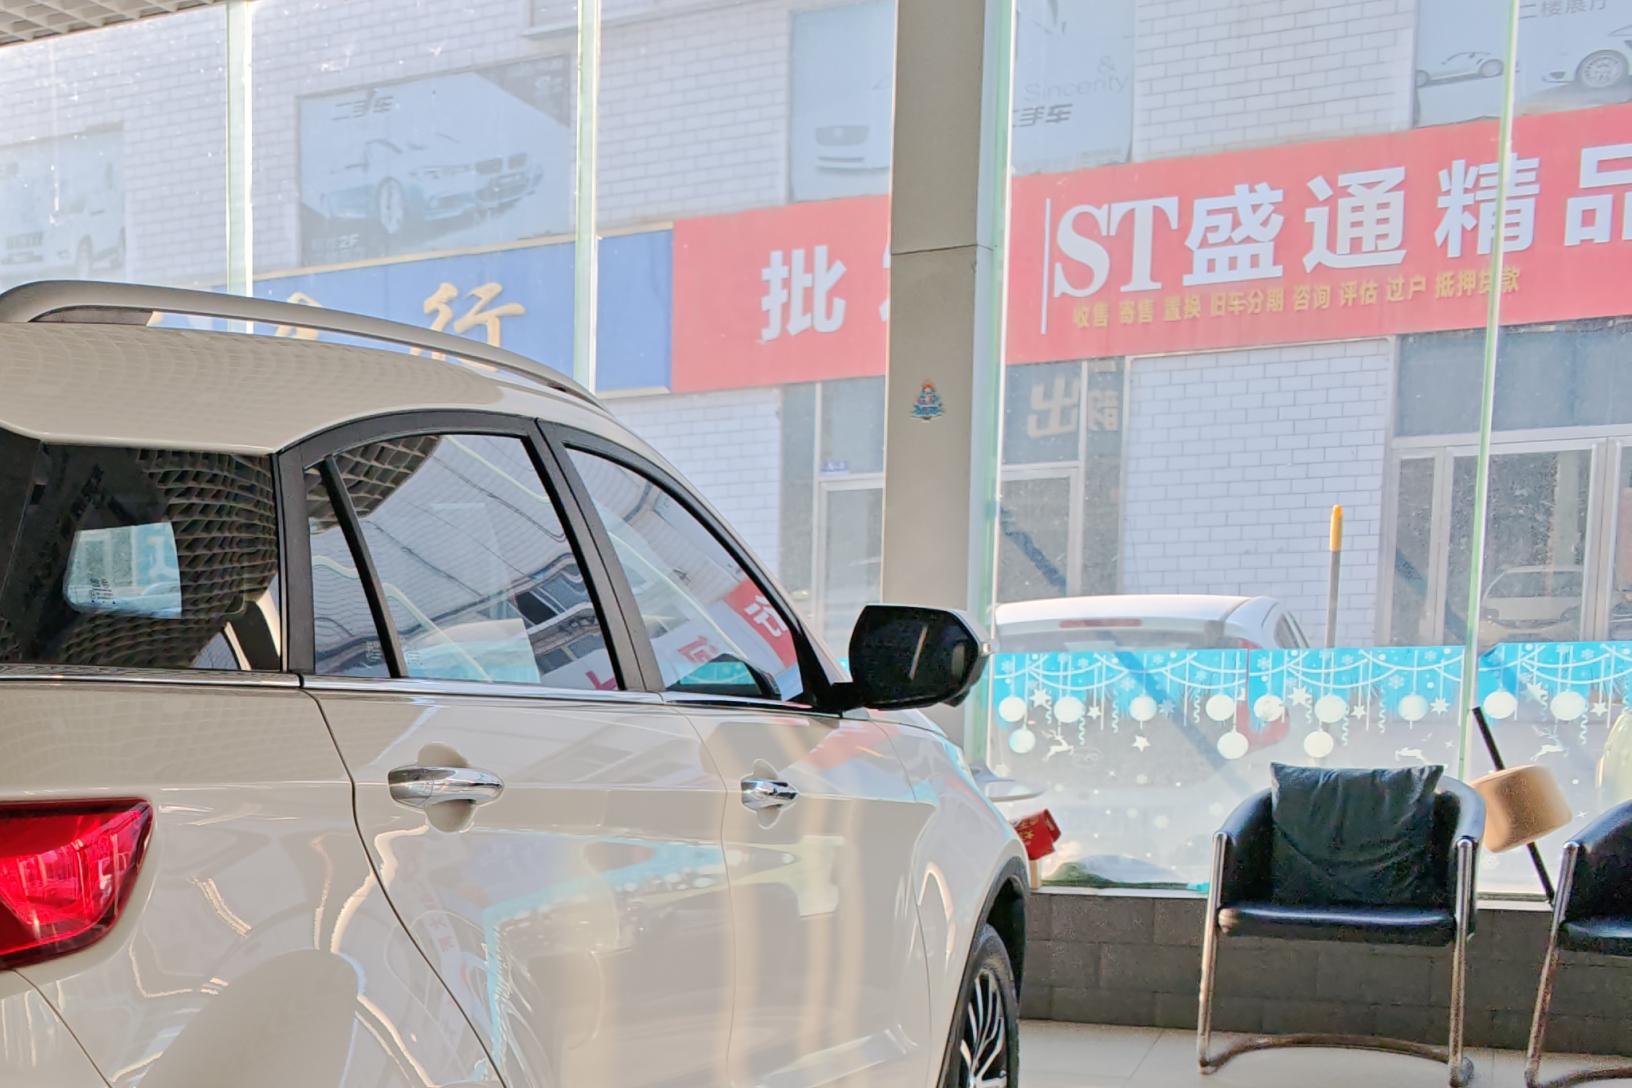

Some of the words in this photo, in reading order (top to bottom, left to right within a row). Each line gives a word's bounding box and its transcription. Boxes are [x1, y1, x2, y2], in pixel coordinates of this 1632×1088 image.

[1013, 103, 1073, 128] 手车
[1292, 283, 1332, 313] 咨询
[1339, 279, 1379, 307] 评估
[1386, 274, 1426, 302] 过户
